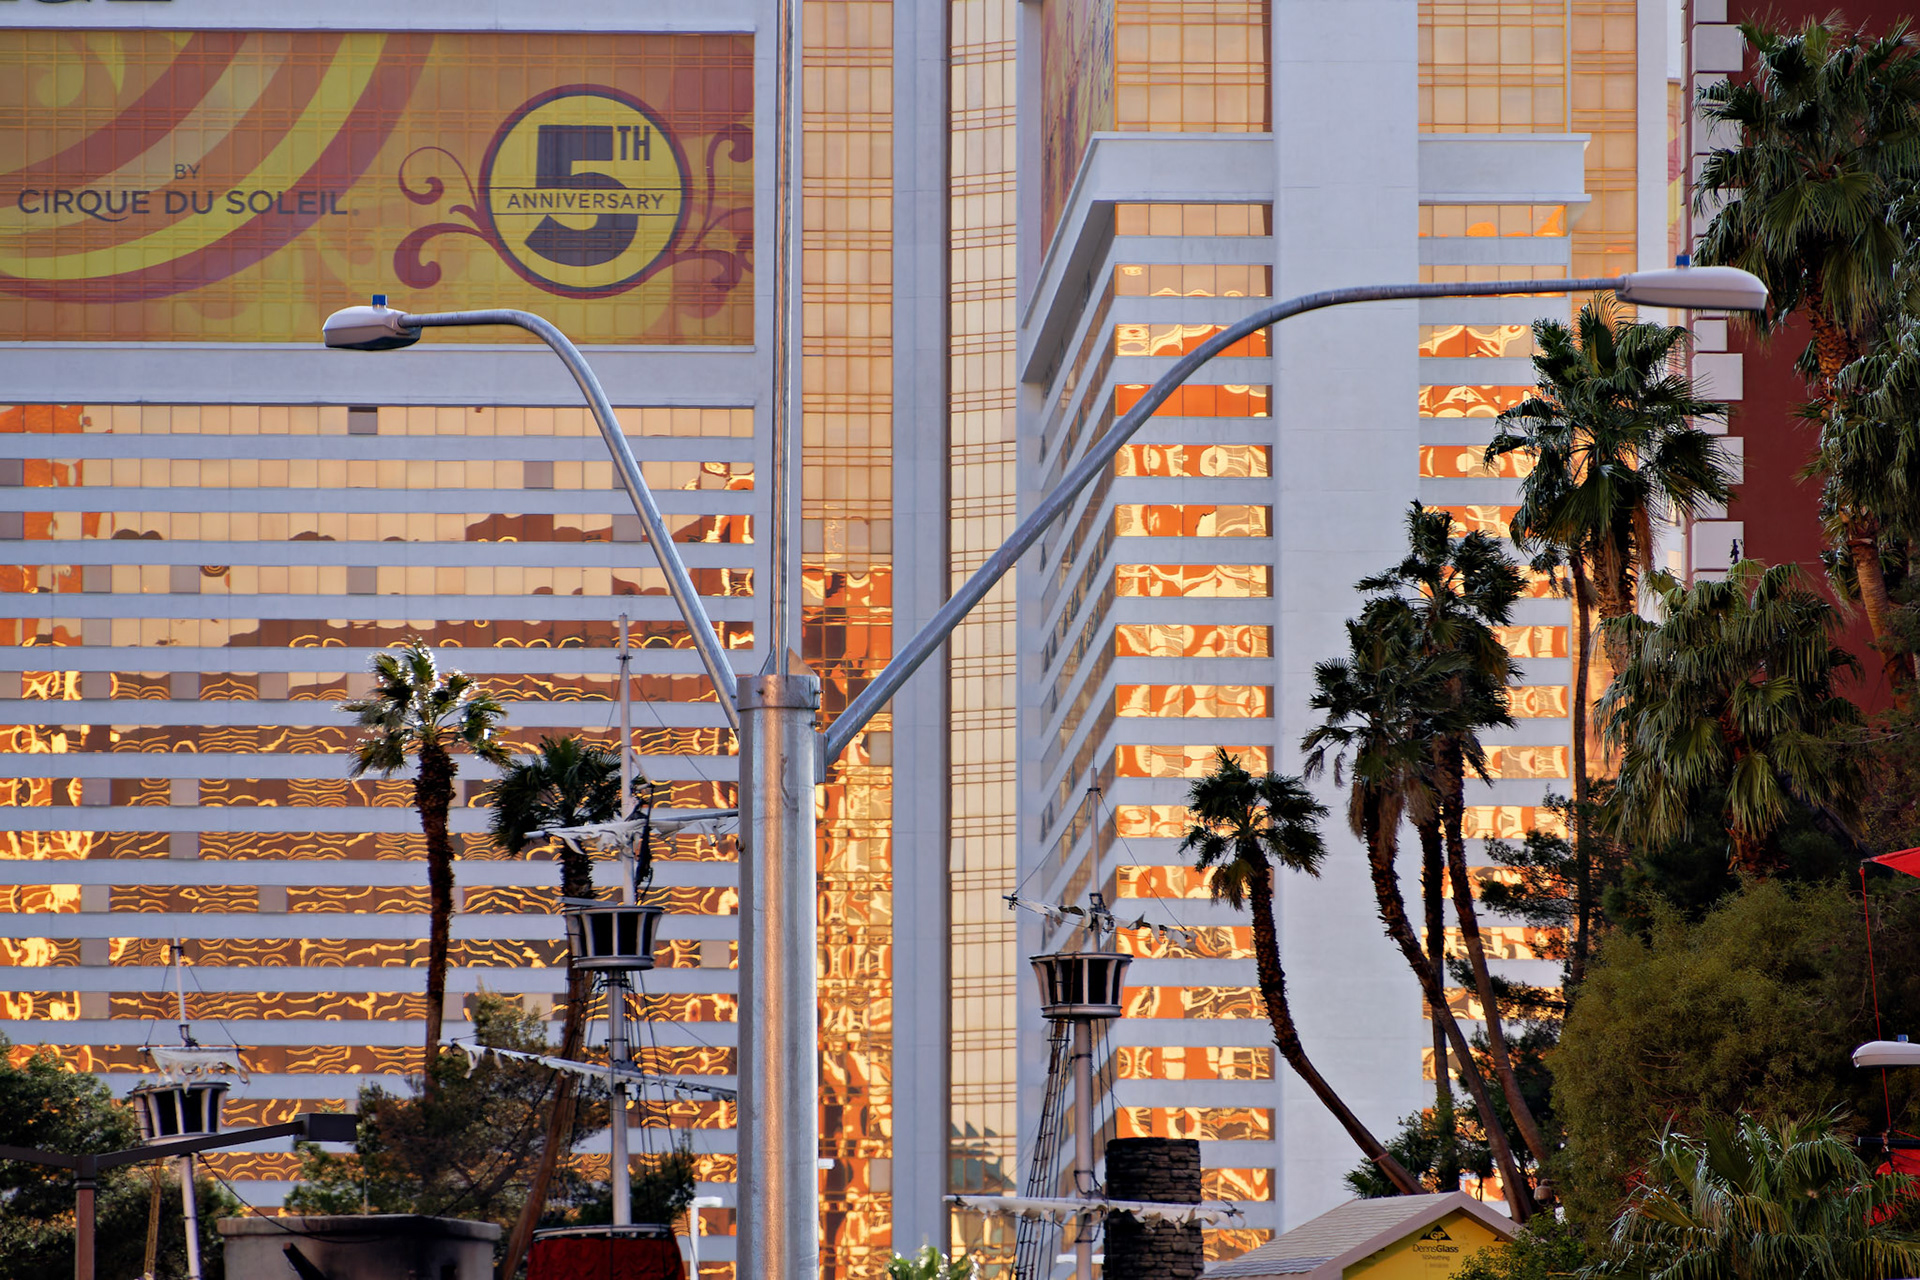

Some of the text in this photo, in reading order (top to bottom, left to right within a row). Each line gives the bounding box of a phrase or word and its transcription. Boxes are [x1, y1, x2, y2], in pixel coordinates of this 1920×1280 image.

[174, 164, 200, 180] BY
[17, 189, 348, 222] CIRQUE DU SOLEIL
[507, 193, 665, 210] ANNIVERSARY
